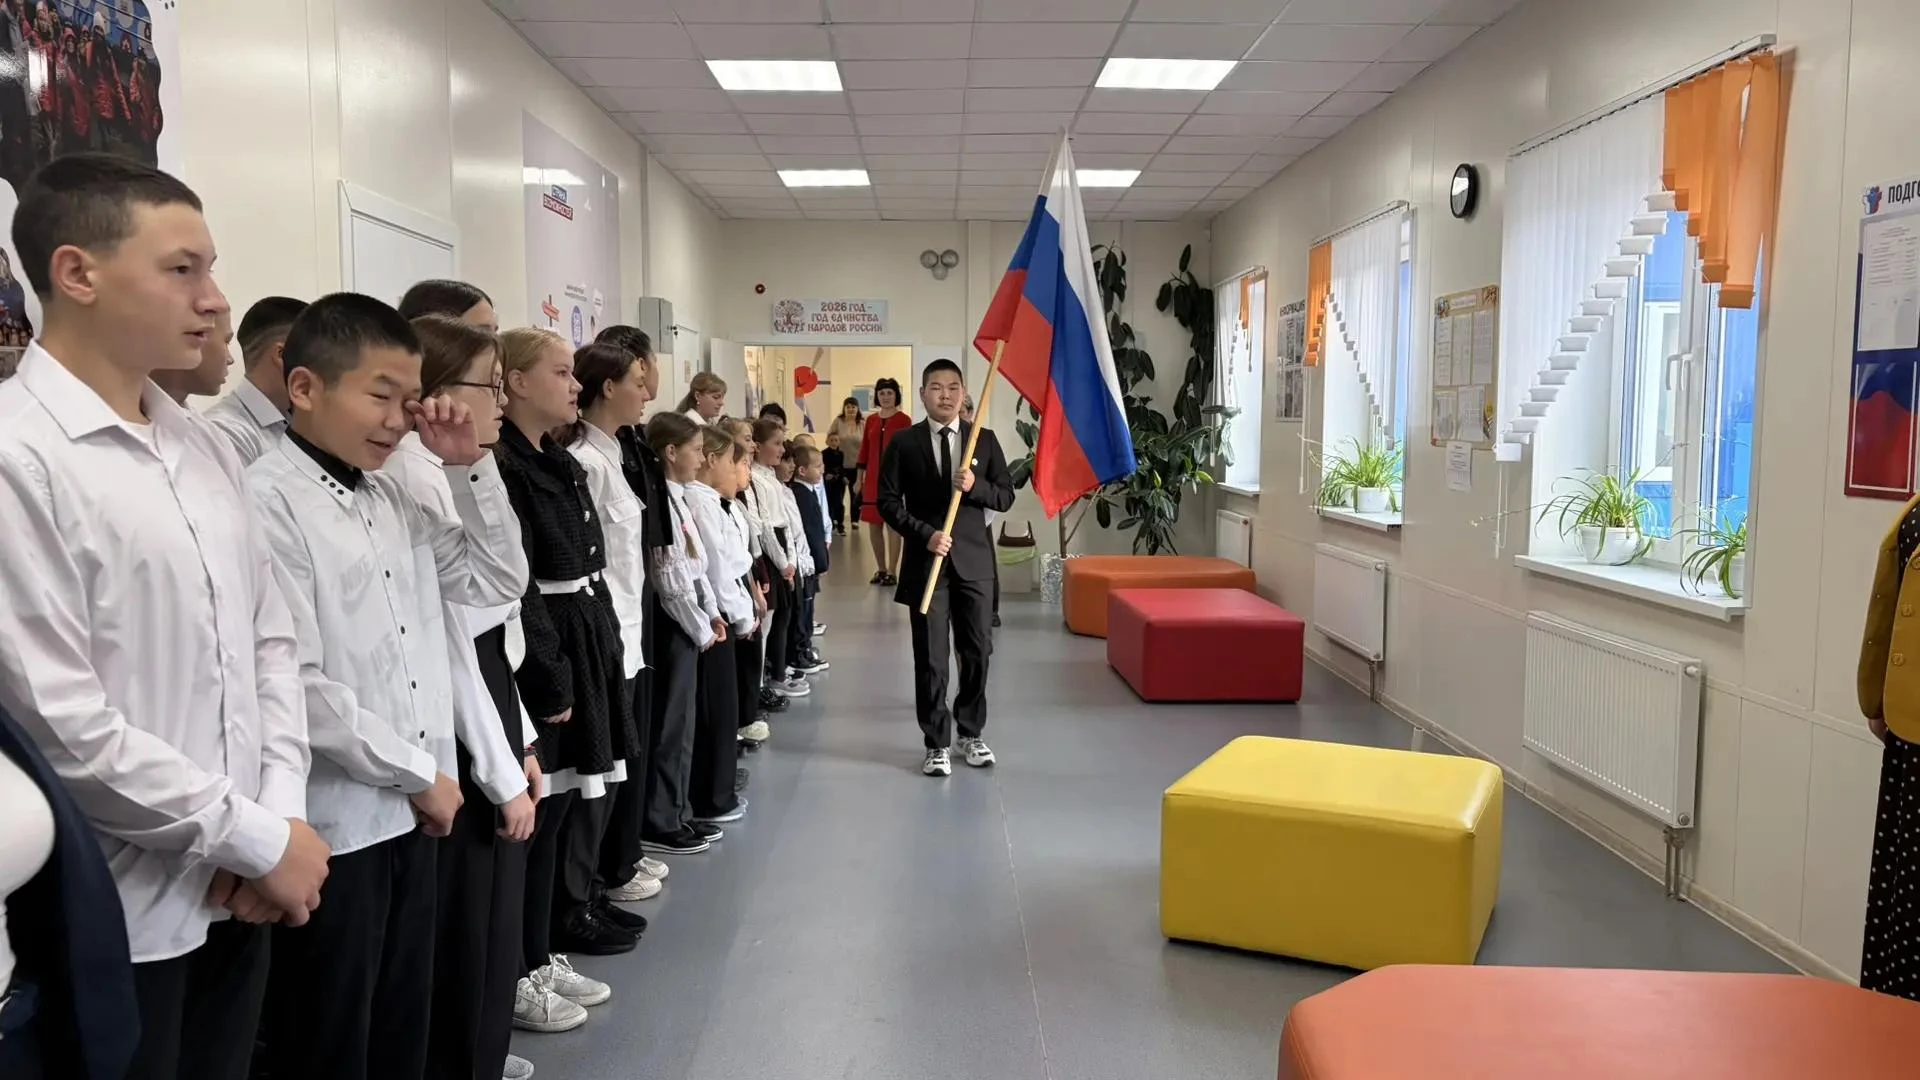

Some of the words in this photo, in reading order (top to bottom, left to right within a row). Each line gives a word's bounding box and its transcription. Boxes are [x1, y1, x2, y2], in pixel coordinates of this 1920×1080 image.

[821, 302, 847, 312] 2026
[849, 303, 866, 312] ГОД
[811, 313, 829, 322] ГОД
[831, 313, 879, 322] ЕДИНСТВА
[808, 324, 847, 332] НАРОДОВ
[850, 324, 883, 332] РОССИИ
